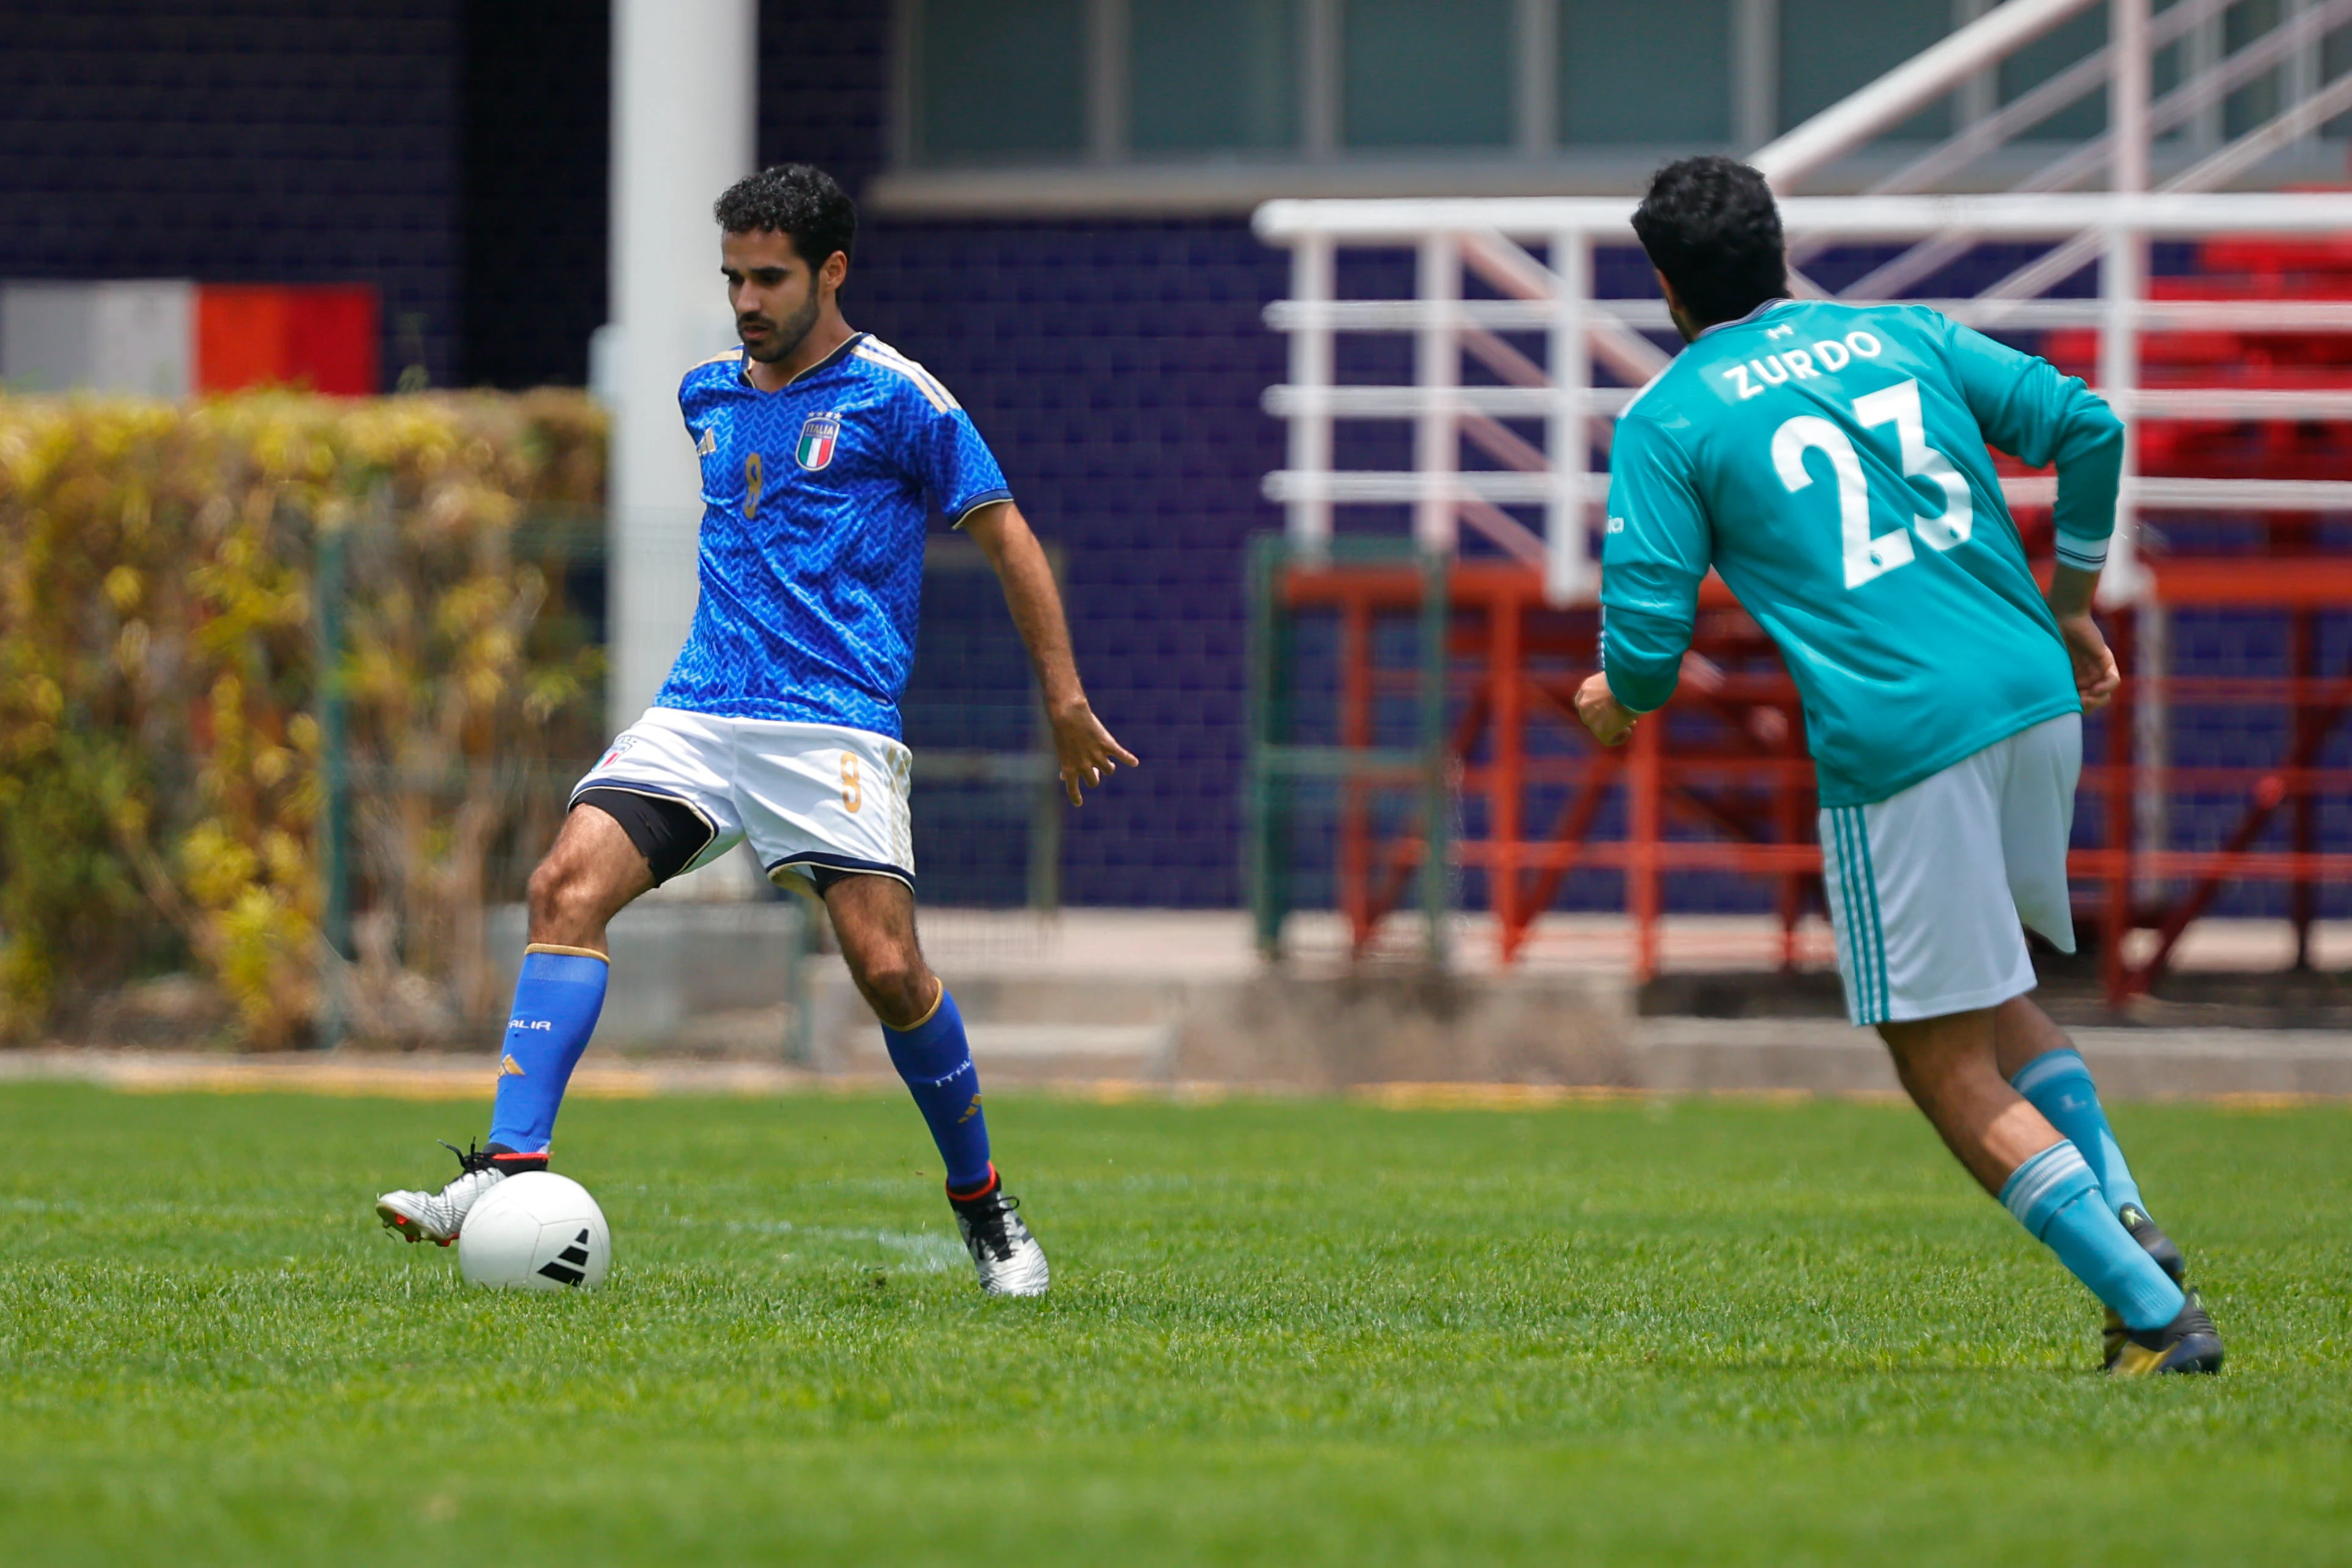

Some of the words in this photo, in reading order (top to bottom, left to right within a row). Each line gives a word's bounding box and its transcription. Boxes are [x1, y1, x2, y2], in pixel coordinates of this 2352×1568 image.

[1722, 331, 1882, 400] ZURDO
[805, 423, 833, 434] ITALIA
[1771, 378, 1973, 590] 23
[508, 1019, 552, 1031] ALIA
